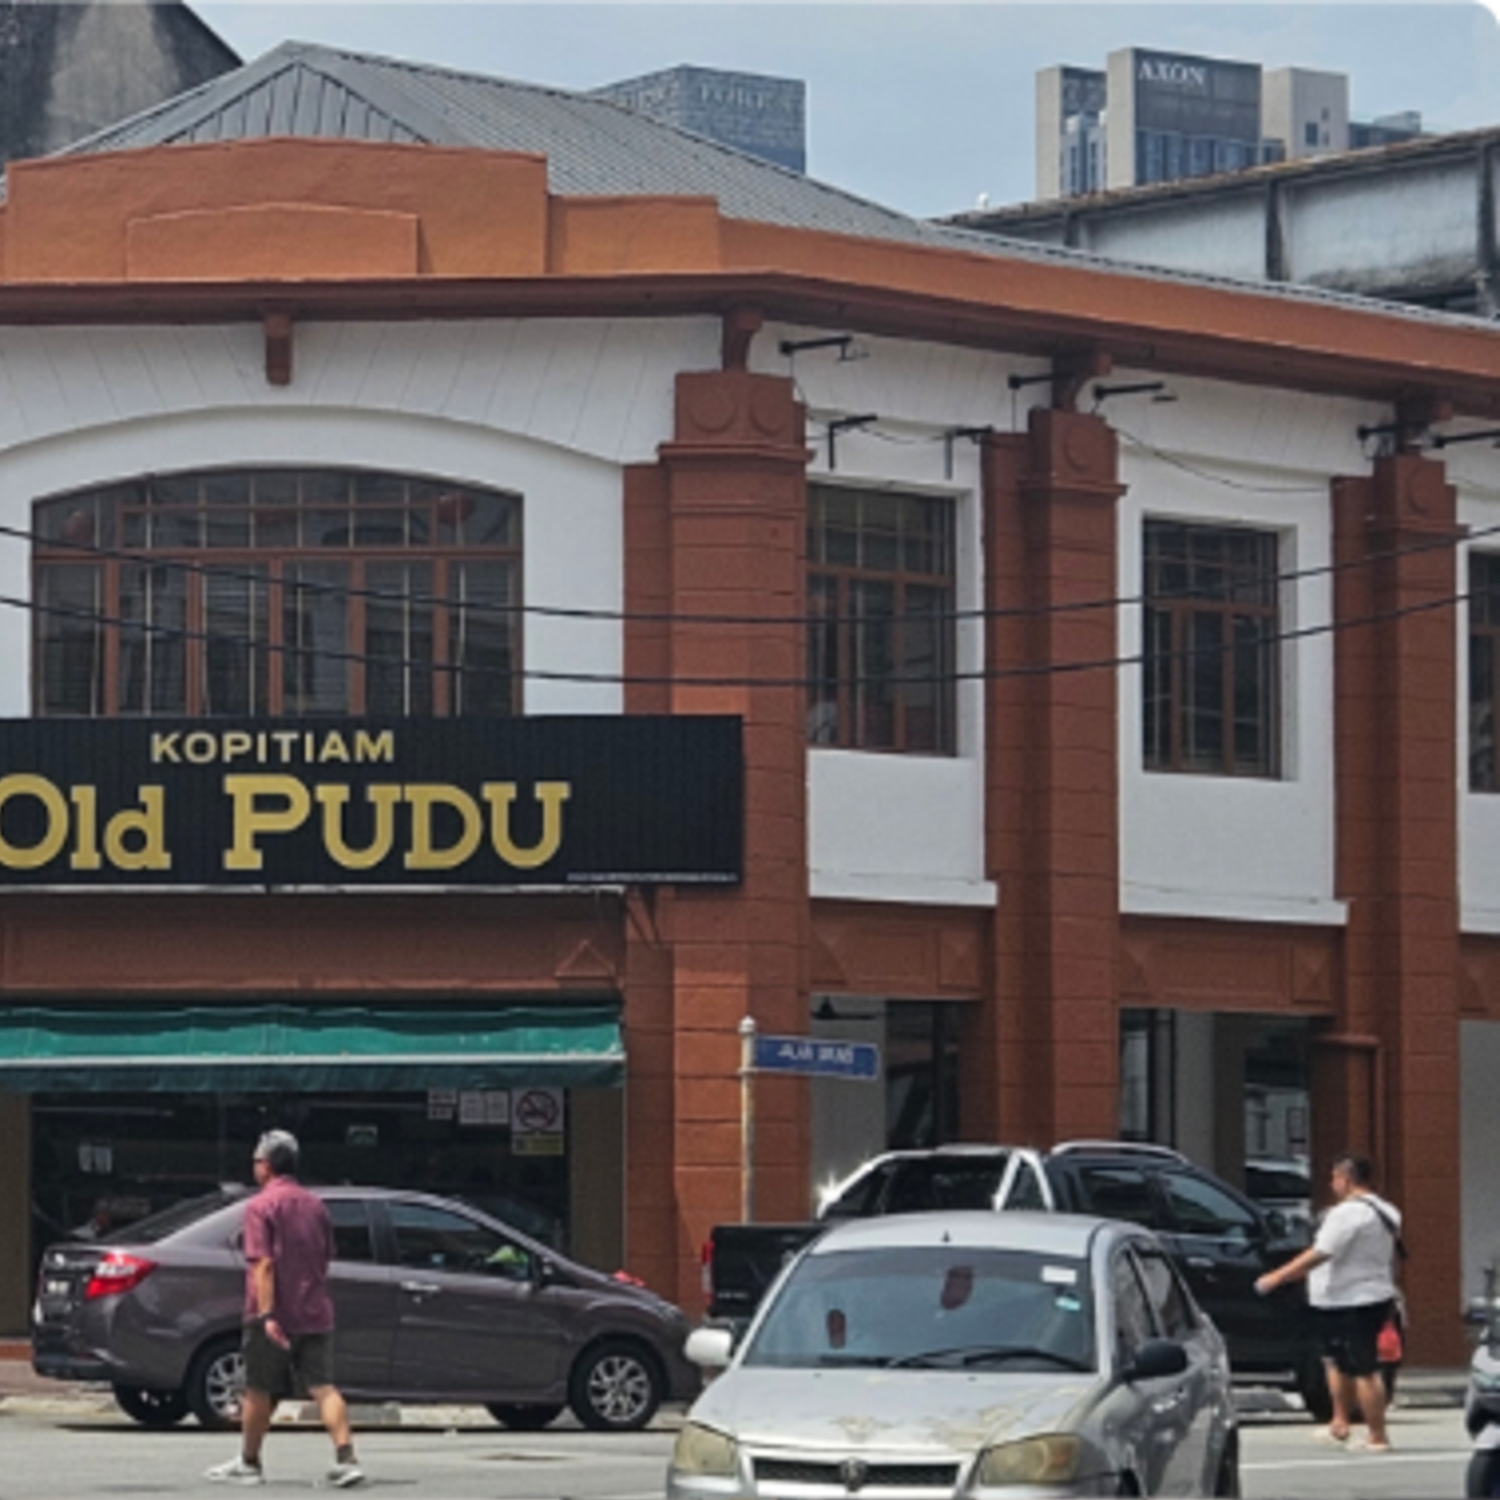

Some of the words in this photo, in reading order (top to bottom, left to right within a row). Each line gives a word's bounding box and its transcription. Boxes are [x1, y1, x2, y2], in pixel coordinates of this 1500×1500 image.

[1139, 60, 1207, 86] AXON
[151, 731, 396, 763] KOPITIAM
[223, 774, 570, 869] PUDU
